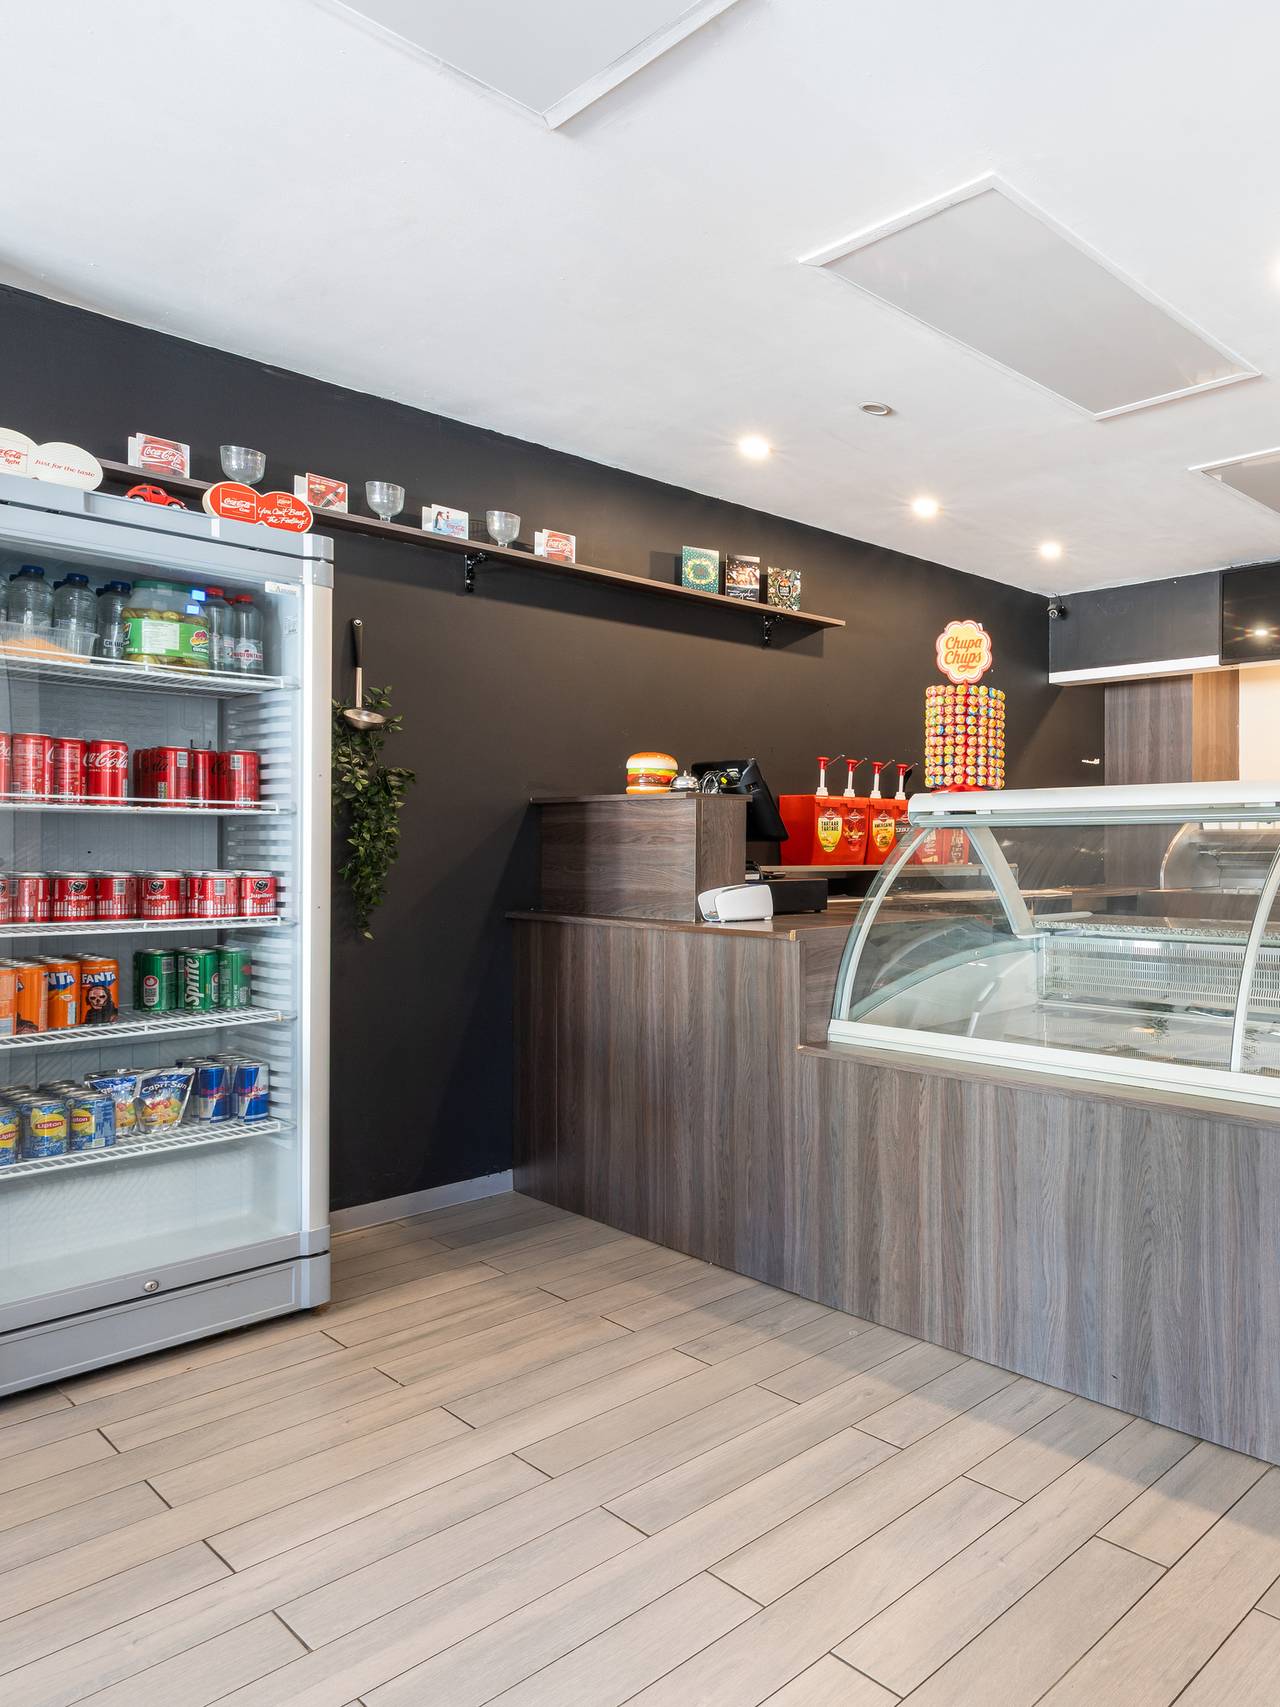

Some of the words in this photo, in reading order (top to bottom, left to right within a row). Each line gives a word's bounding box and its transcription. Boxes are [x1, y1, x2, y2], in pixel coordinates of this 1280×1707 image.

[51, 462, 62, 470] for
[63, 465, 76, 473] the
[77, 468, 96, 478] taste
[945, 636, 983, 652] Chupa
[944, 650, 982, 673] Chups
[47, 971, 75, 985] NTA
[82, 971, 117, 984] FANTA
[184, 957, 205, 1006] Sprite
[141, 1081, 187, 1094] Capri-Sun
[36, 1120, 62, 1130] Lipton
